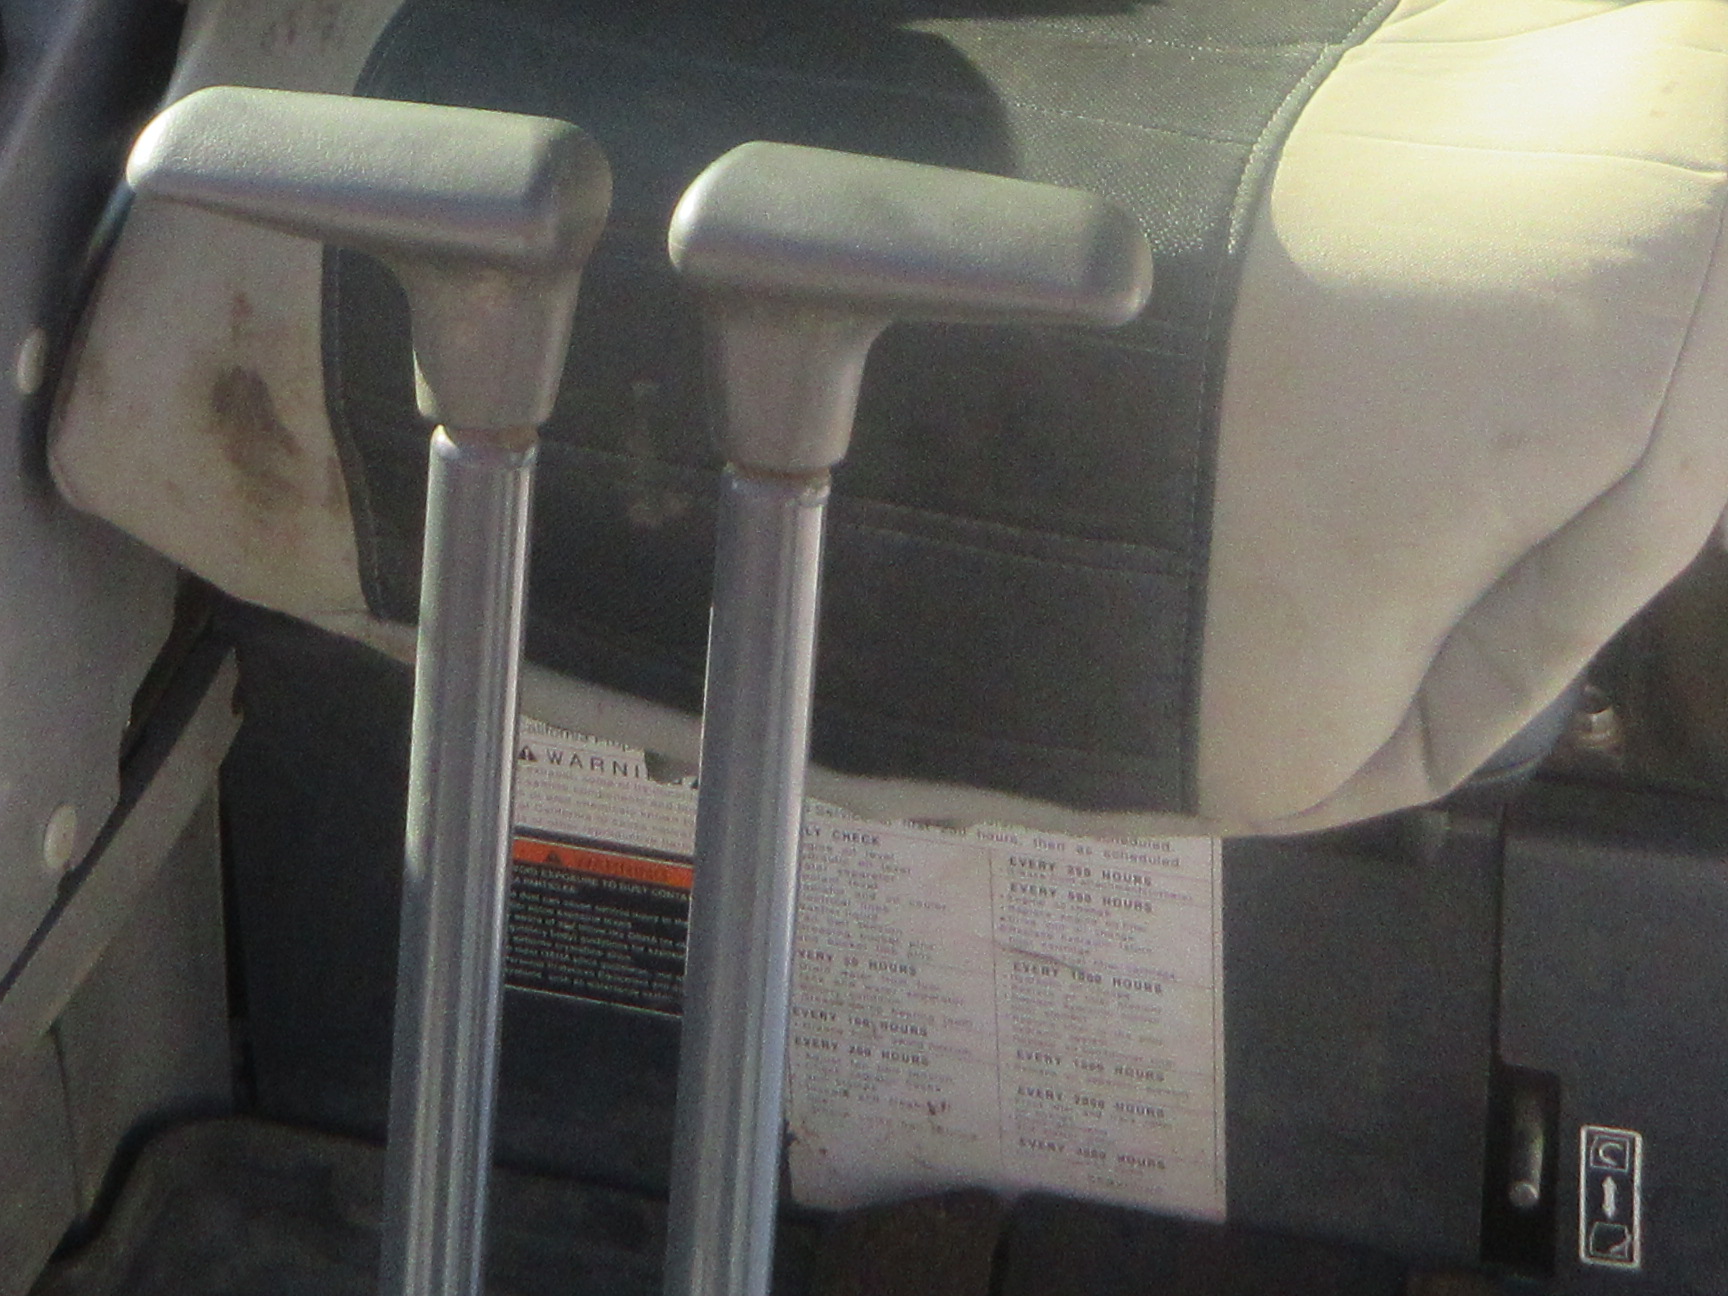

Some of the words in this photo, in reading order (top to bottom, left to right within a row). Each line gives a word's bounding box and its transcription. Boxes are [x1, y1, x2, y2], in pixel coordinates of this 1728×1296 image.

[546, 747, 641, 779] WARNI
[832, 830, 881, 846] CHECK
[1033, 836, 1066, 852] then
[1103, 848, 1181, 868] scheduled
[1009, 856, 1058, 873] EVERY
[1102, 870, 1153, 888] HOURS
[652, 888, 688, 902] CONTA
[1010, 882, 1058, 899] EVERY
[1102, 896, 1154, 914] HOURS
[796, 949, 834, 963] VERY
[869, 960, 918, 977] HOURS
[1013, 961, 1060, 978] EVERY
[1112, 976, 1163, 994] HOURS
[792, 1005, 837, 1023] EVERY
[880, 1020, 929, 1038] HOURS
[794, 1036, 839, 1053] EVERY
[881, 1049, 930, 1067] HOURS
[1016, 1048, 1062, 1067] EVERY
[1114, 1065, 1166, 1083] HOURS
[1017, 1084, 1063, 1103] EVERY
[1113, 1101, 1165, 1119] HOURS
[1018, 1136, 1065, 1155] EVERY
[1117, 1152, 1167, 1171] HOURS
